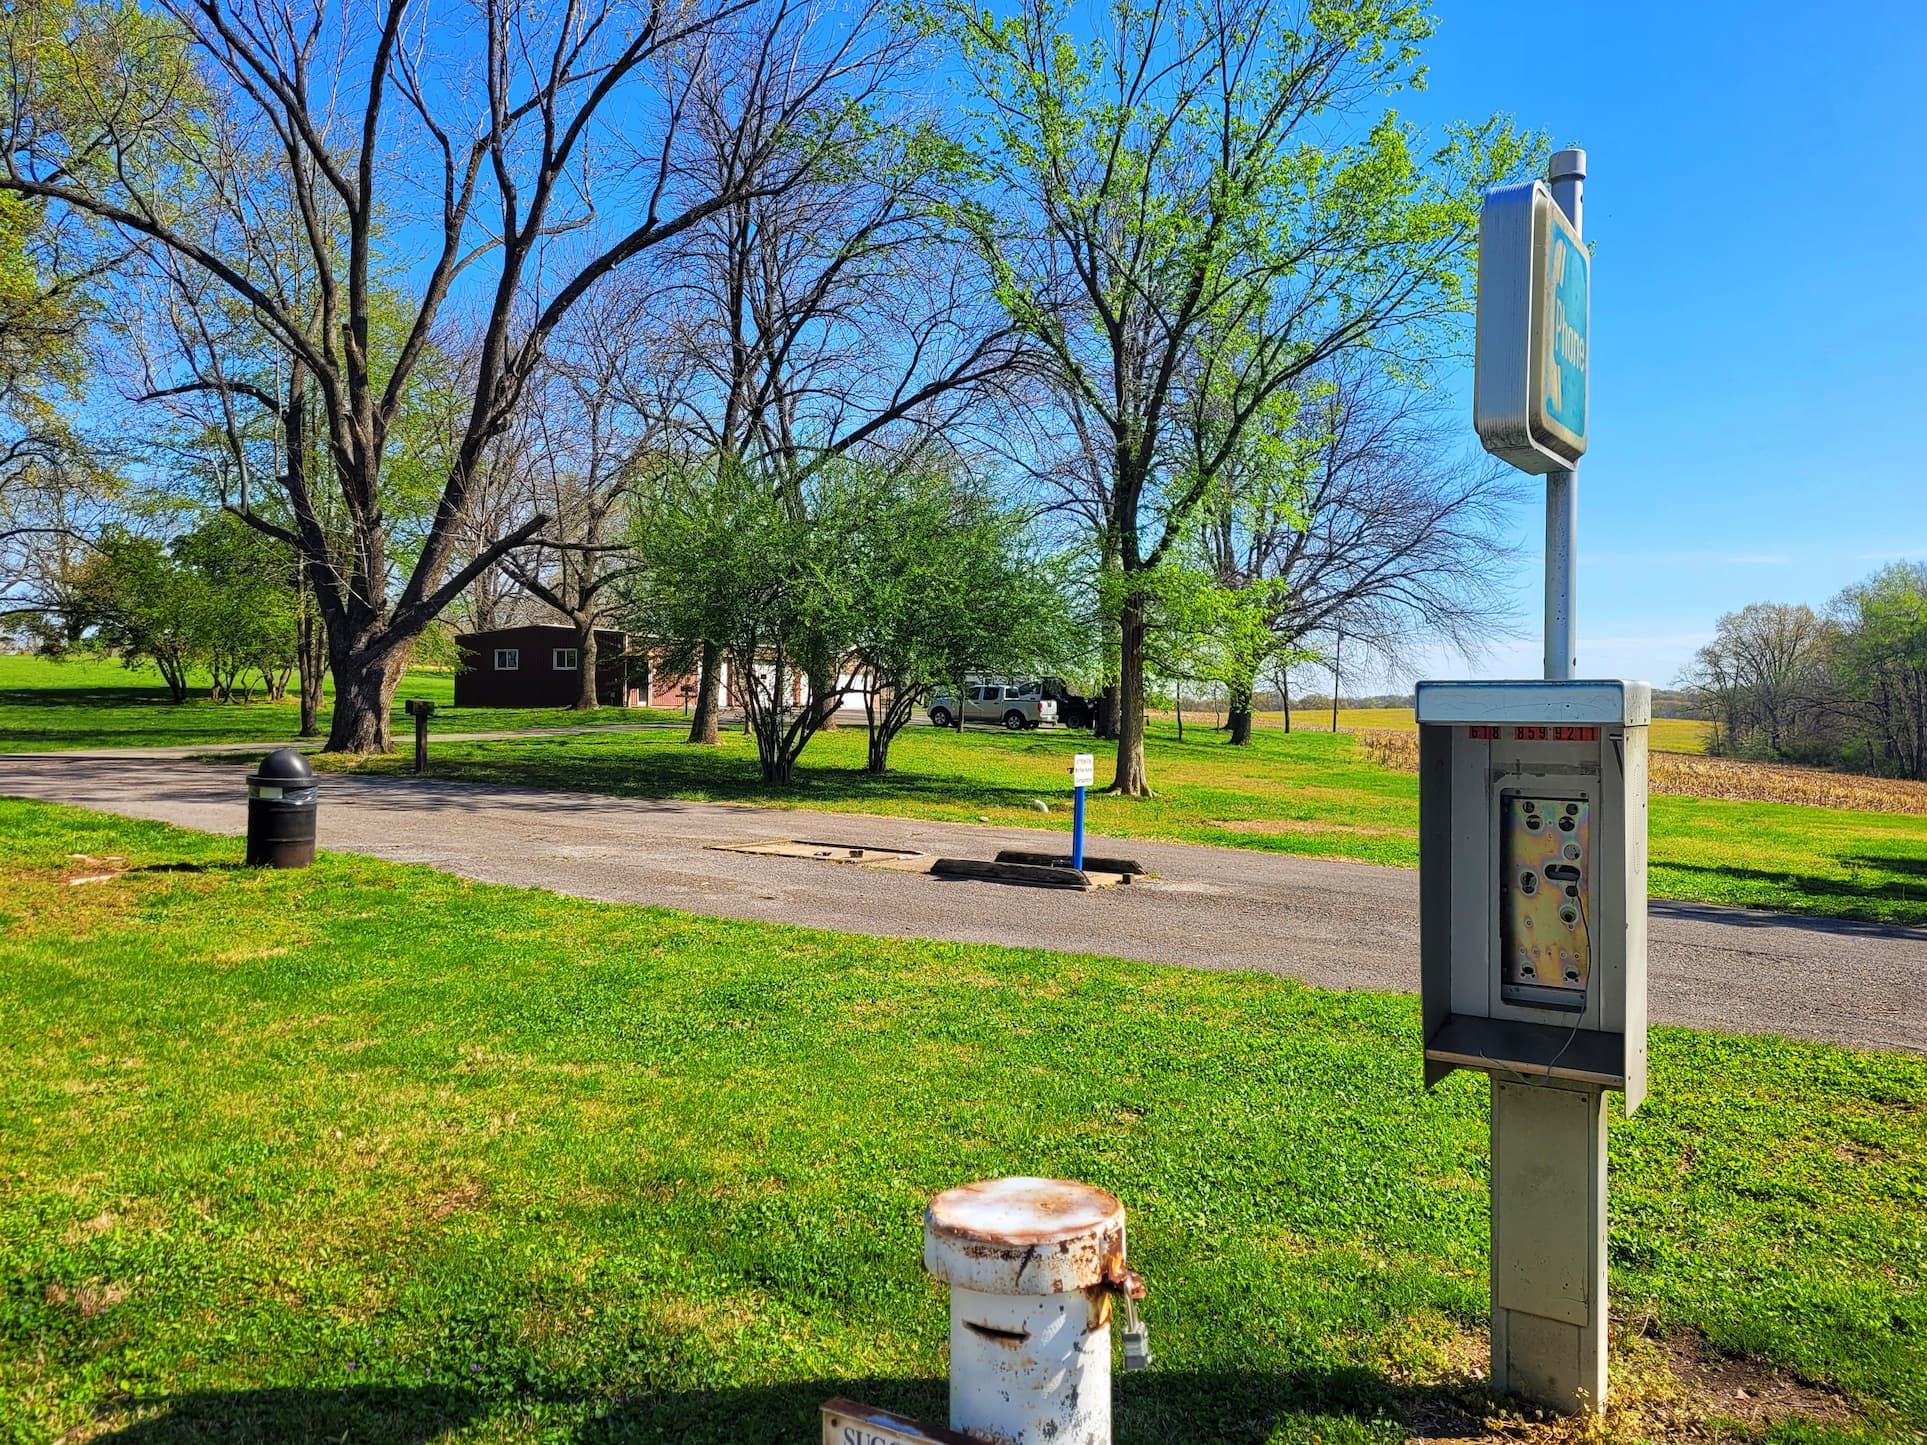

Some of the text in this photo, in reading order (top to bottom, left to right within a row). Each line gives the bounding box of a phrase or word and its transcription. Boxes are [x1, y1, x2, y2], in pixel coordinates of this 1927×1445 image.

[1556, 299, 1585, 371] Phone
[1471, 726, 1595, 741] 618 859 9211
